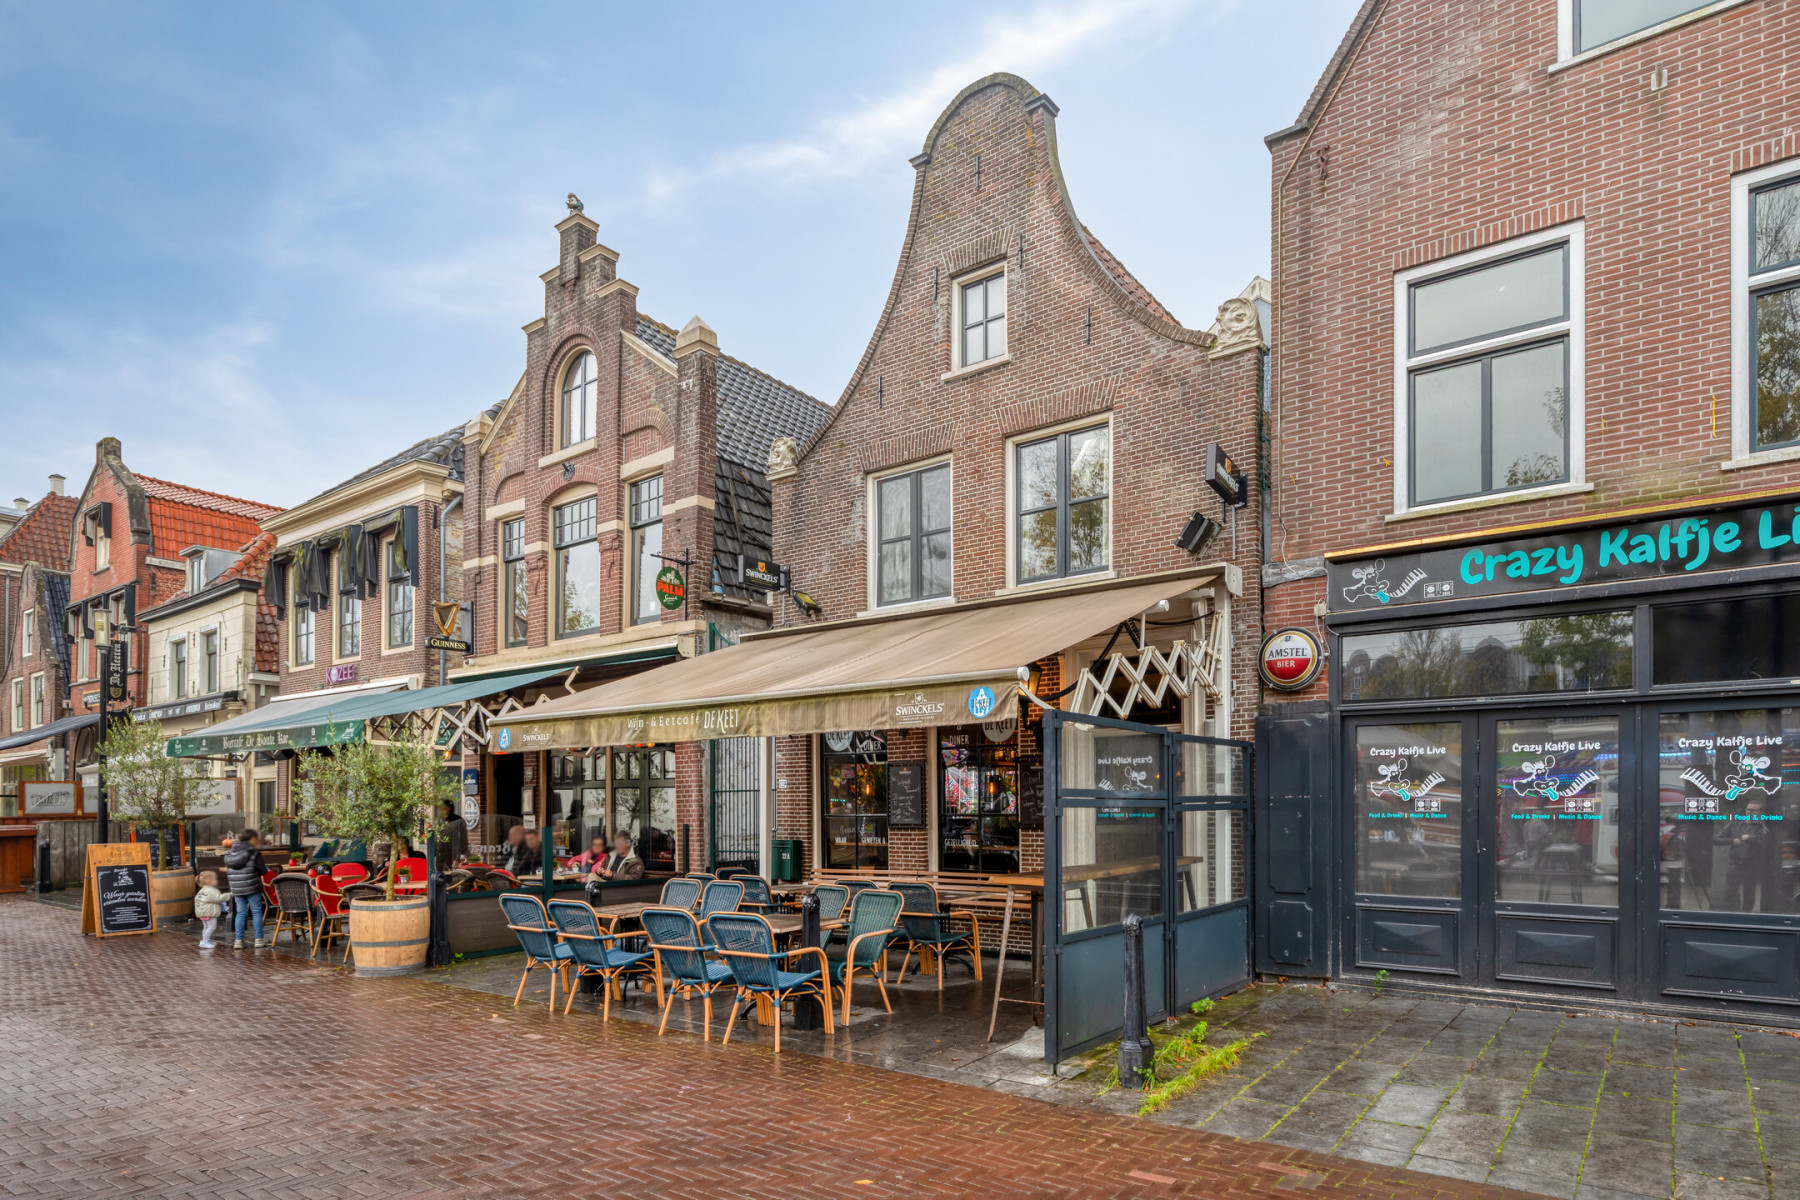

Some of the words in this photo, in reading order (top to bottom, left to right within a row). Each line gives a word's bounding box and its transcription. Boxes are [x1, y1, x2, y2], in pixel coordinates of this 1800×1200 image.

[1459, 543, 1584, 585] Crazy
[1599, 518, 1742, 571] Kalfje
[656, 581, 684, 597] PALM
[430, 638, 466, 650] GUINNESS
[1268, 647, 1307, 658] AMSTEL
[1276, 660, 1295, 668] BIER
[651, 716, 657, 727] &
[659, 712, 700, 727] Eetcafé
[703, 711, 715, 729] DE
[717, 709, 739, 734] KEET
[949, 735, 969, 745] DINER
[1678, 737, 1714, 750] Crazy
[1716, 736, 1753, 749] Kalfje
[1756, 735, 1783, 746] Live
[1370, 747, 1396, 758] Crazy
[1398, 746, 1425, 757] Kalfje
[1427, 745, 1447, 755] Live
[1512, 743, 1542, 755] Crazy
[1544, 741, 1576, 754] Kalfje
[1578, 741, 1601, 751] Live
